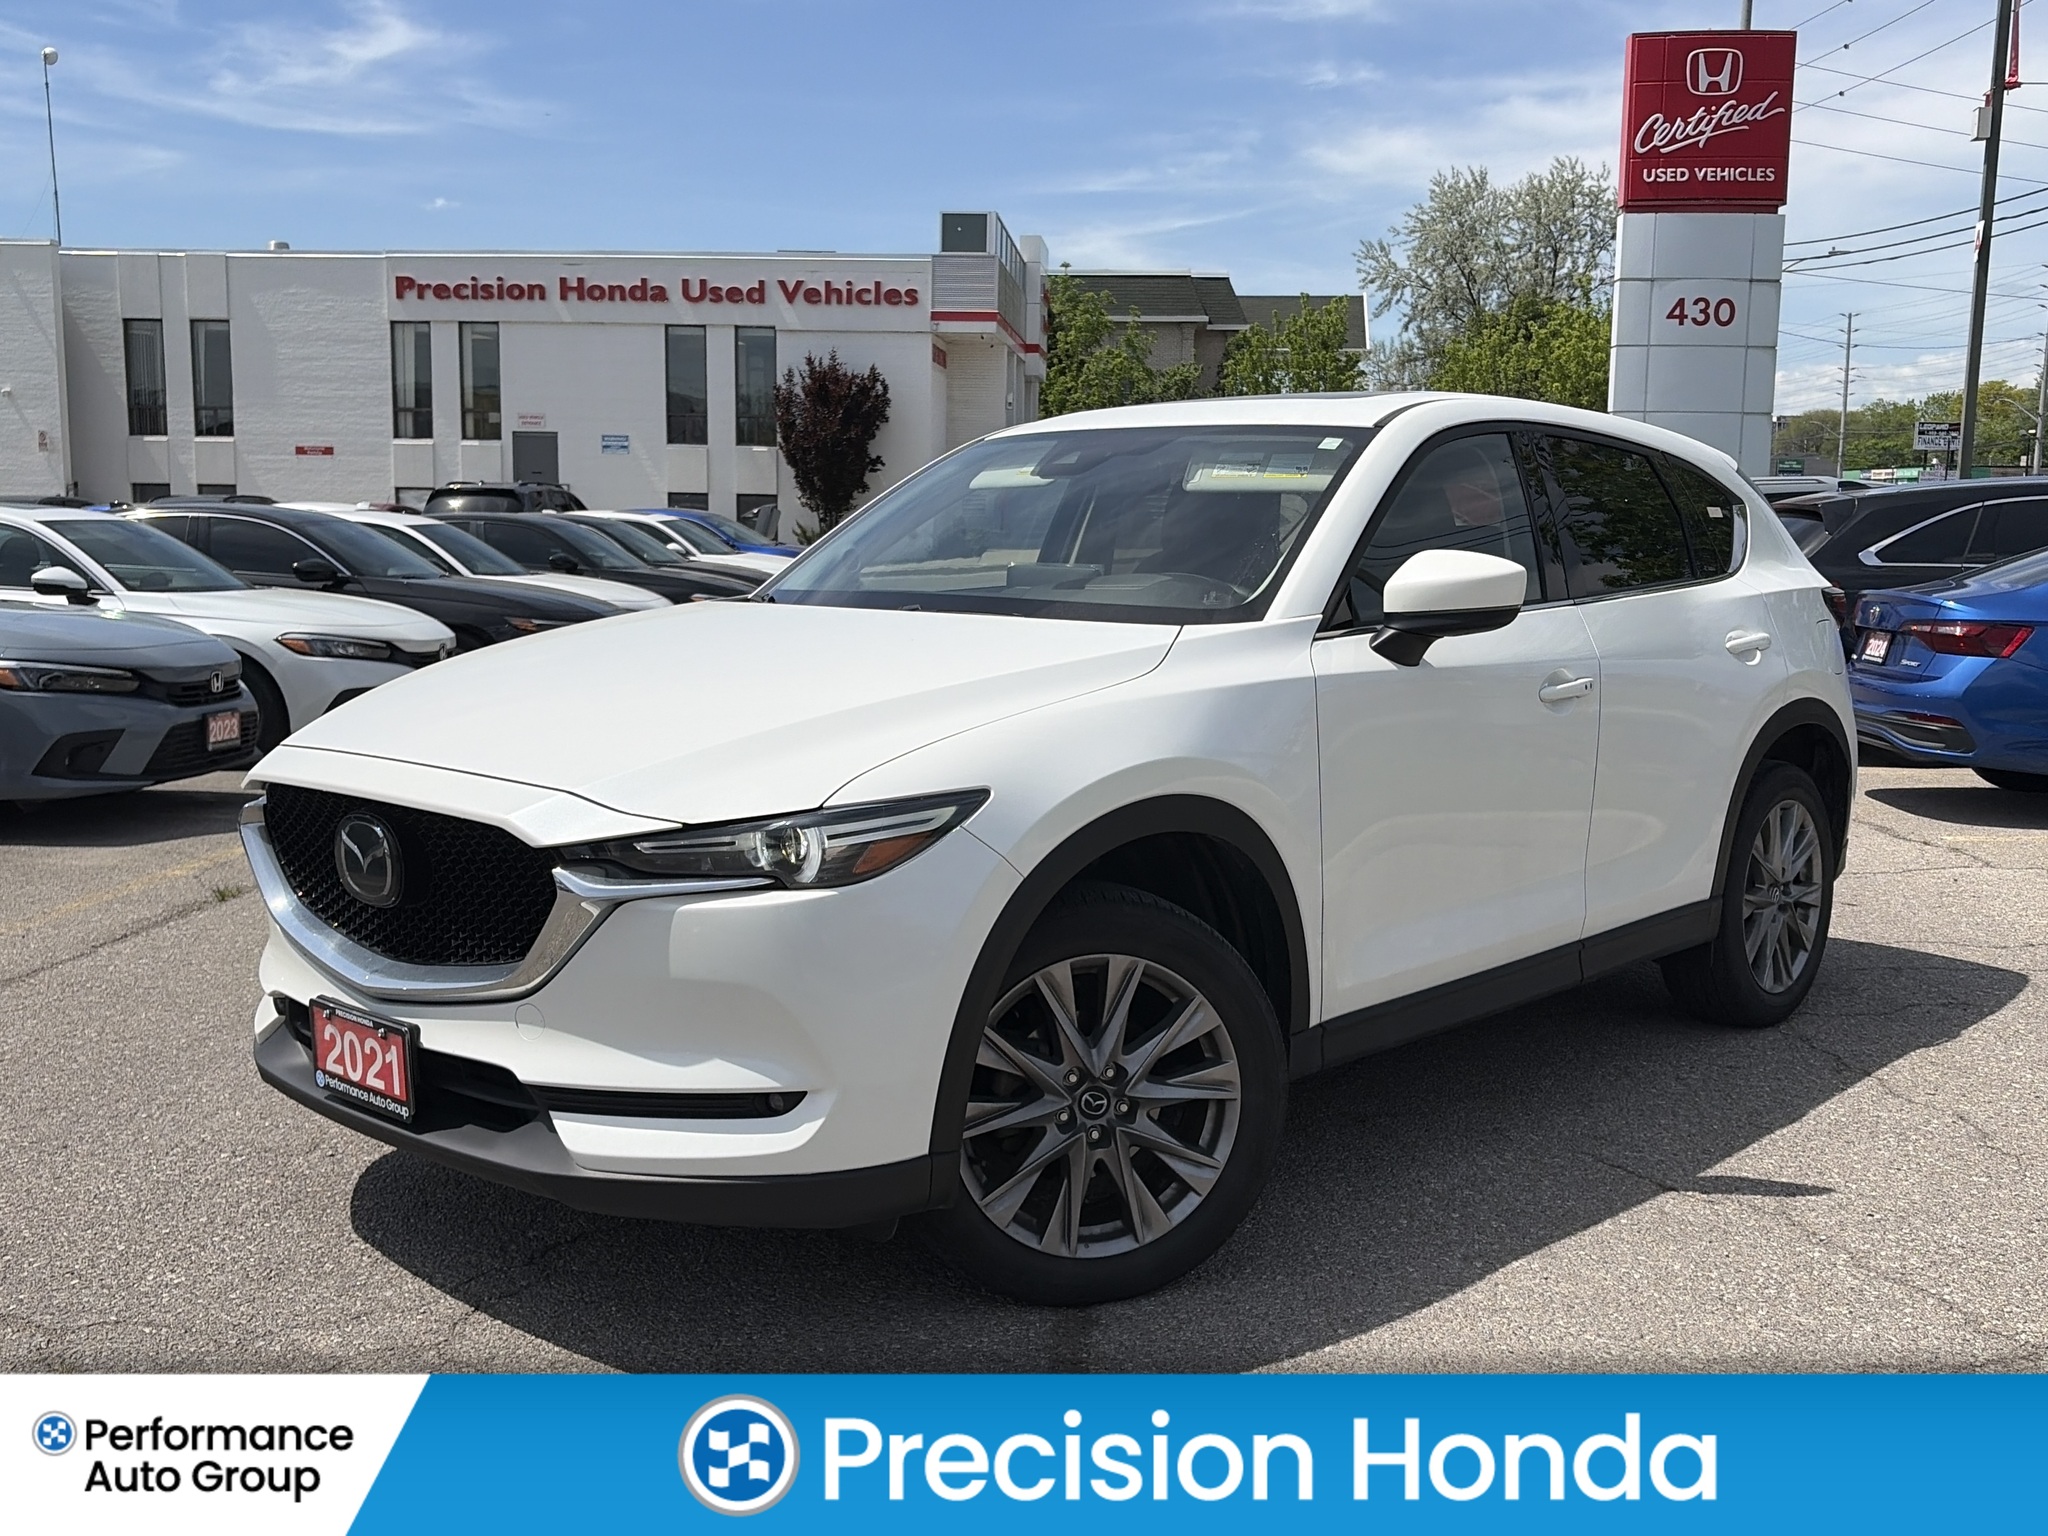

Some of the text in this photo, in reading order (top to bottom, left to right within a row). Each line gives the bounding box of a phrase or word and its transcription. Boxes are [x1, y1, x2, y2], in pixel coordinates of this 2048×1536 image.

[1634, 91, 1785, 154] Certified
[1643, 166, 1775, 183] USED VEHICLES
[395, 275, 919, 305] Precision Honda Used Vehicles
[1666, 297, 1736, 327] 430
[1865, 638, 1888, 658] 2024
[209, 719, 238, 743] 2023
[335, 1009, 373, 1027] PRECISION HONDA
[324, 1024, 400, 1096] 2021
[325, 1074, 409, 1119] Performance Auto Group
